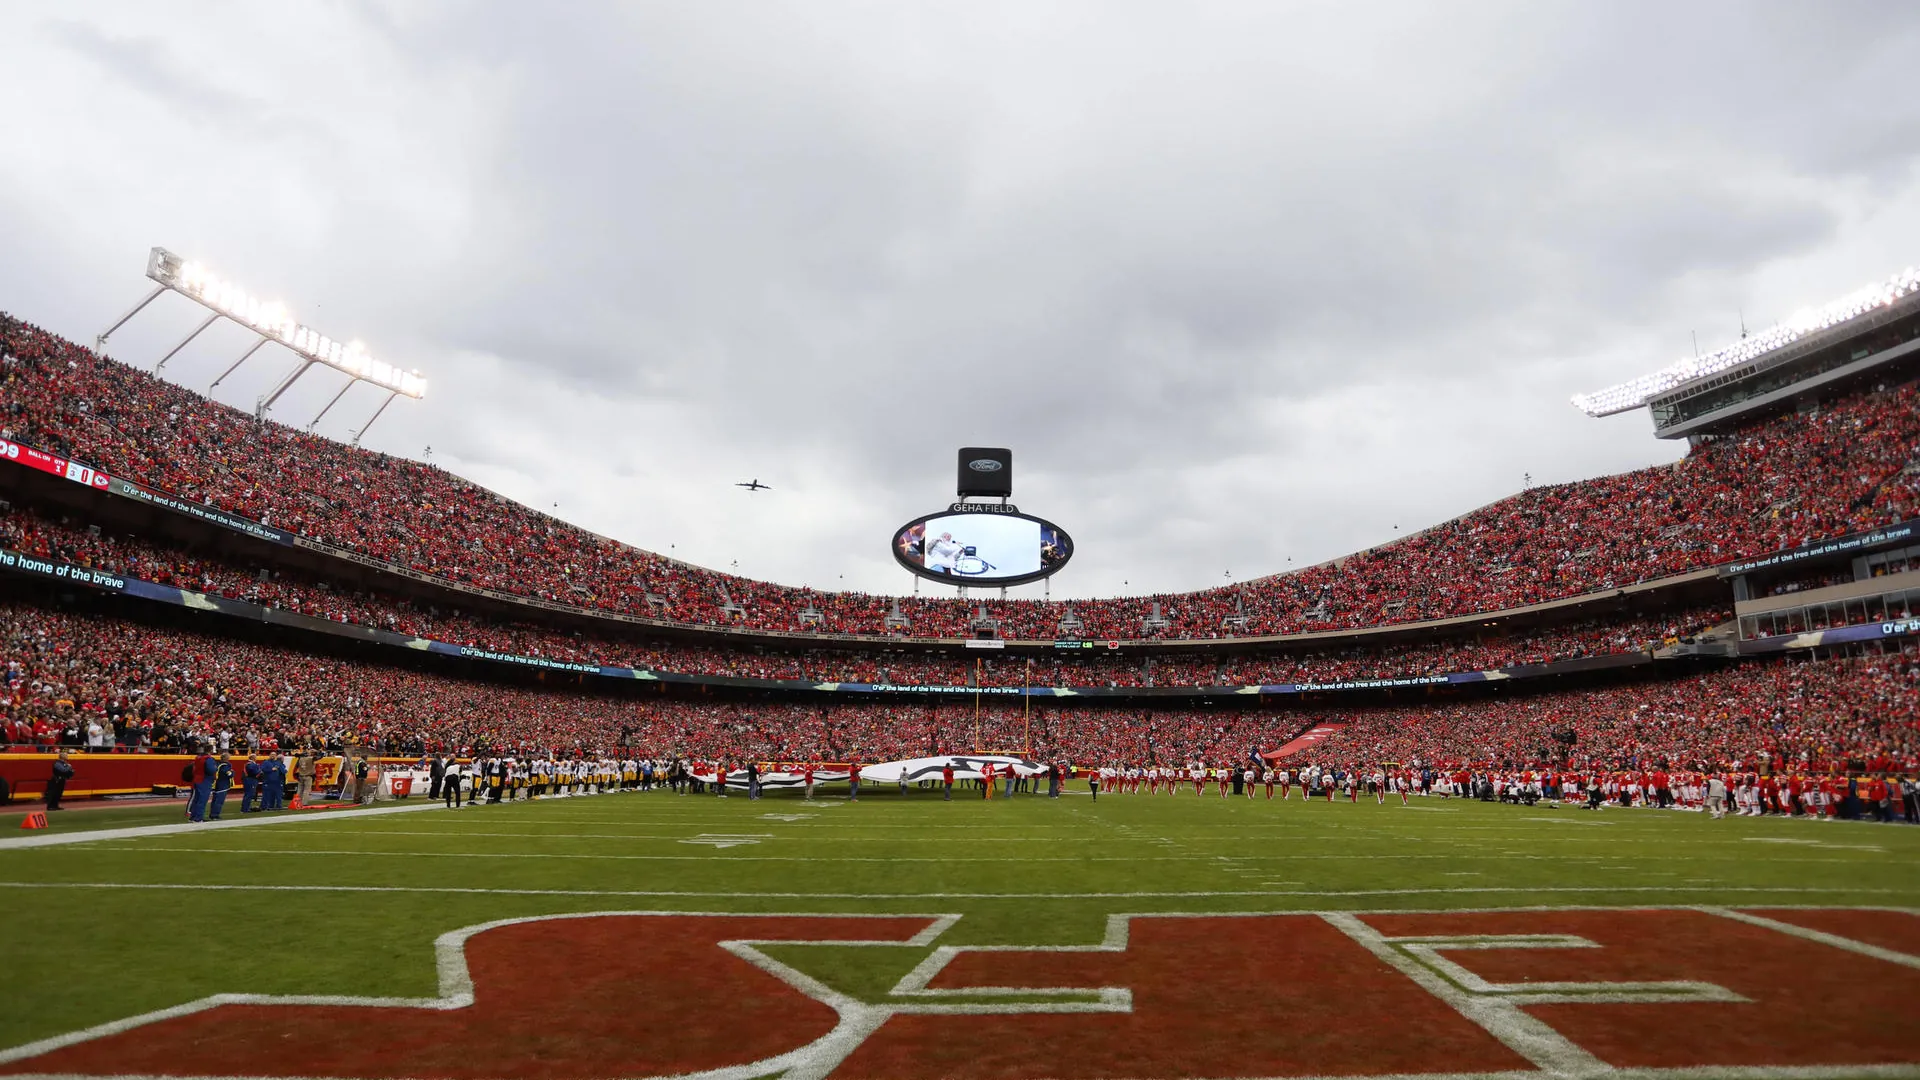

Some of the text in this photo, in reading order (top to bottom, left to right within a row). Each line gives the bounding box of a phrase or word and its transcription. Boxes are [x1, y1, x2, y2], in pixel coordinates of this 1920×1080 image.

[28, 450, 51, 462] BALL ON
[123, 485, 139, 495] O'er
[140, 491, 152, 500] the
[154, 495, 168, 505] land
[178, 503, 189, 512] the
[190, 506, 203, 516] free
[205, 513, 216, 521] and
[218, 515, 228, 524] the
[229, 519, 246, 530] home
[254, 526, 264, 535] the
[265, 530, 280, 540] brave
[954, 504, 1014, 513] GEHA FIELD
[1772, 556, 1779, 564] of
[1794, 551, 1808, 559] free
[1810, 547, 1823, 556] and
[1825, 544, 1838, 552] the
[1840, 540, 1860, 549] home
[1862, 536, 1870, 544] of
[1872, 534, 1885, 542] the
[1887, 528, 1911, 539] brave
[0, 551, 124, 588] he home of the brave
[1882, 619, 1920, 634] O'er th
[461, 647, 473, 655] O'er
[485, 651, 496, 659] land
[550, 661, 564, 669] home
[394, 781, 402, 790] G
[32, 814, 46, 828] 10
